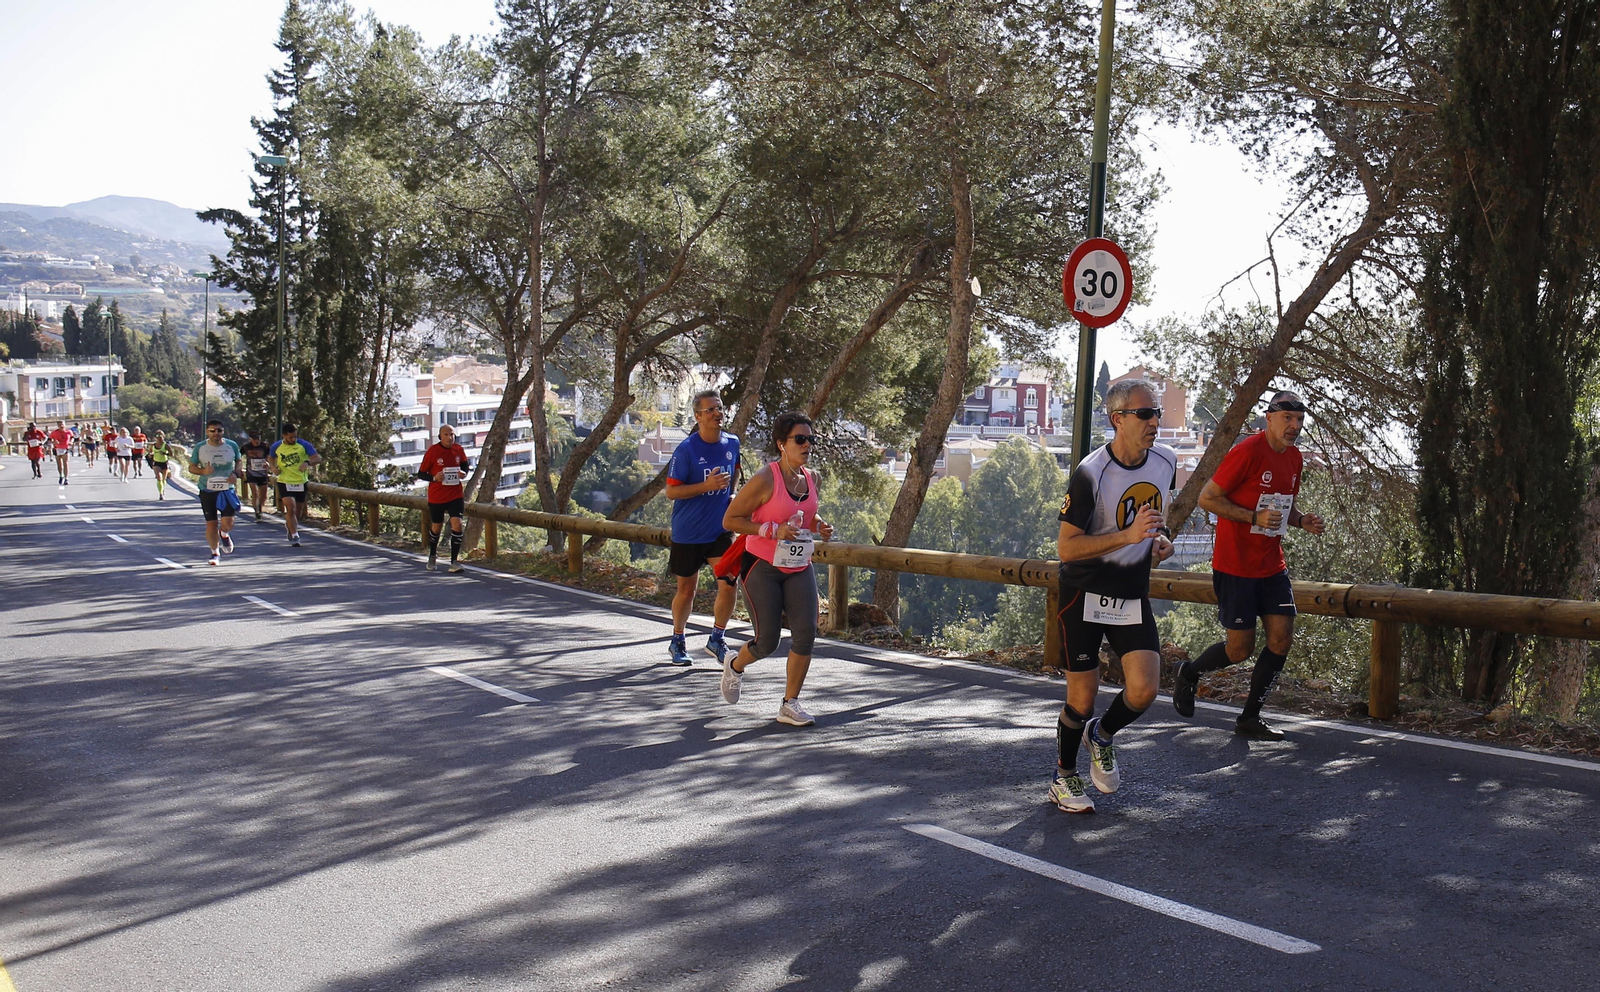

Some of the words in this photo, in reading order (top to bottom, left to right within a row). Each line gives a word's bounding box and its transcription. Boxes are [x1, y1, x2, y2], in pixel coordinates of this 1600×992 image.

[1081, 269, 1117, 298] 30
[789, 545, 804, 557] 92
[1099, 595, 1127, 610] 617
